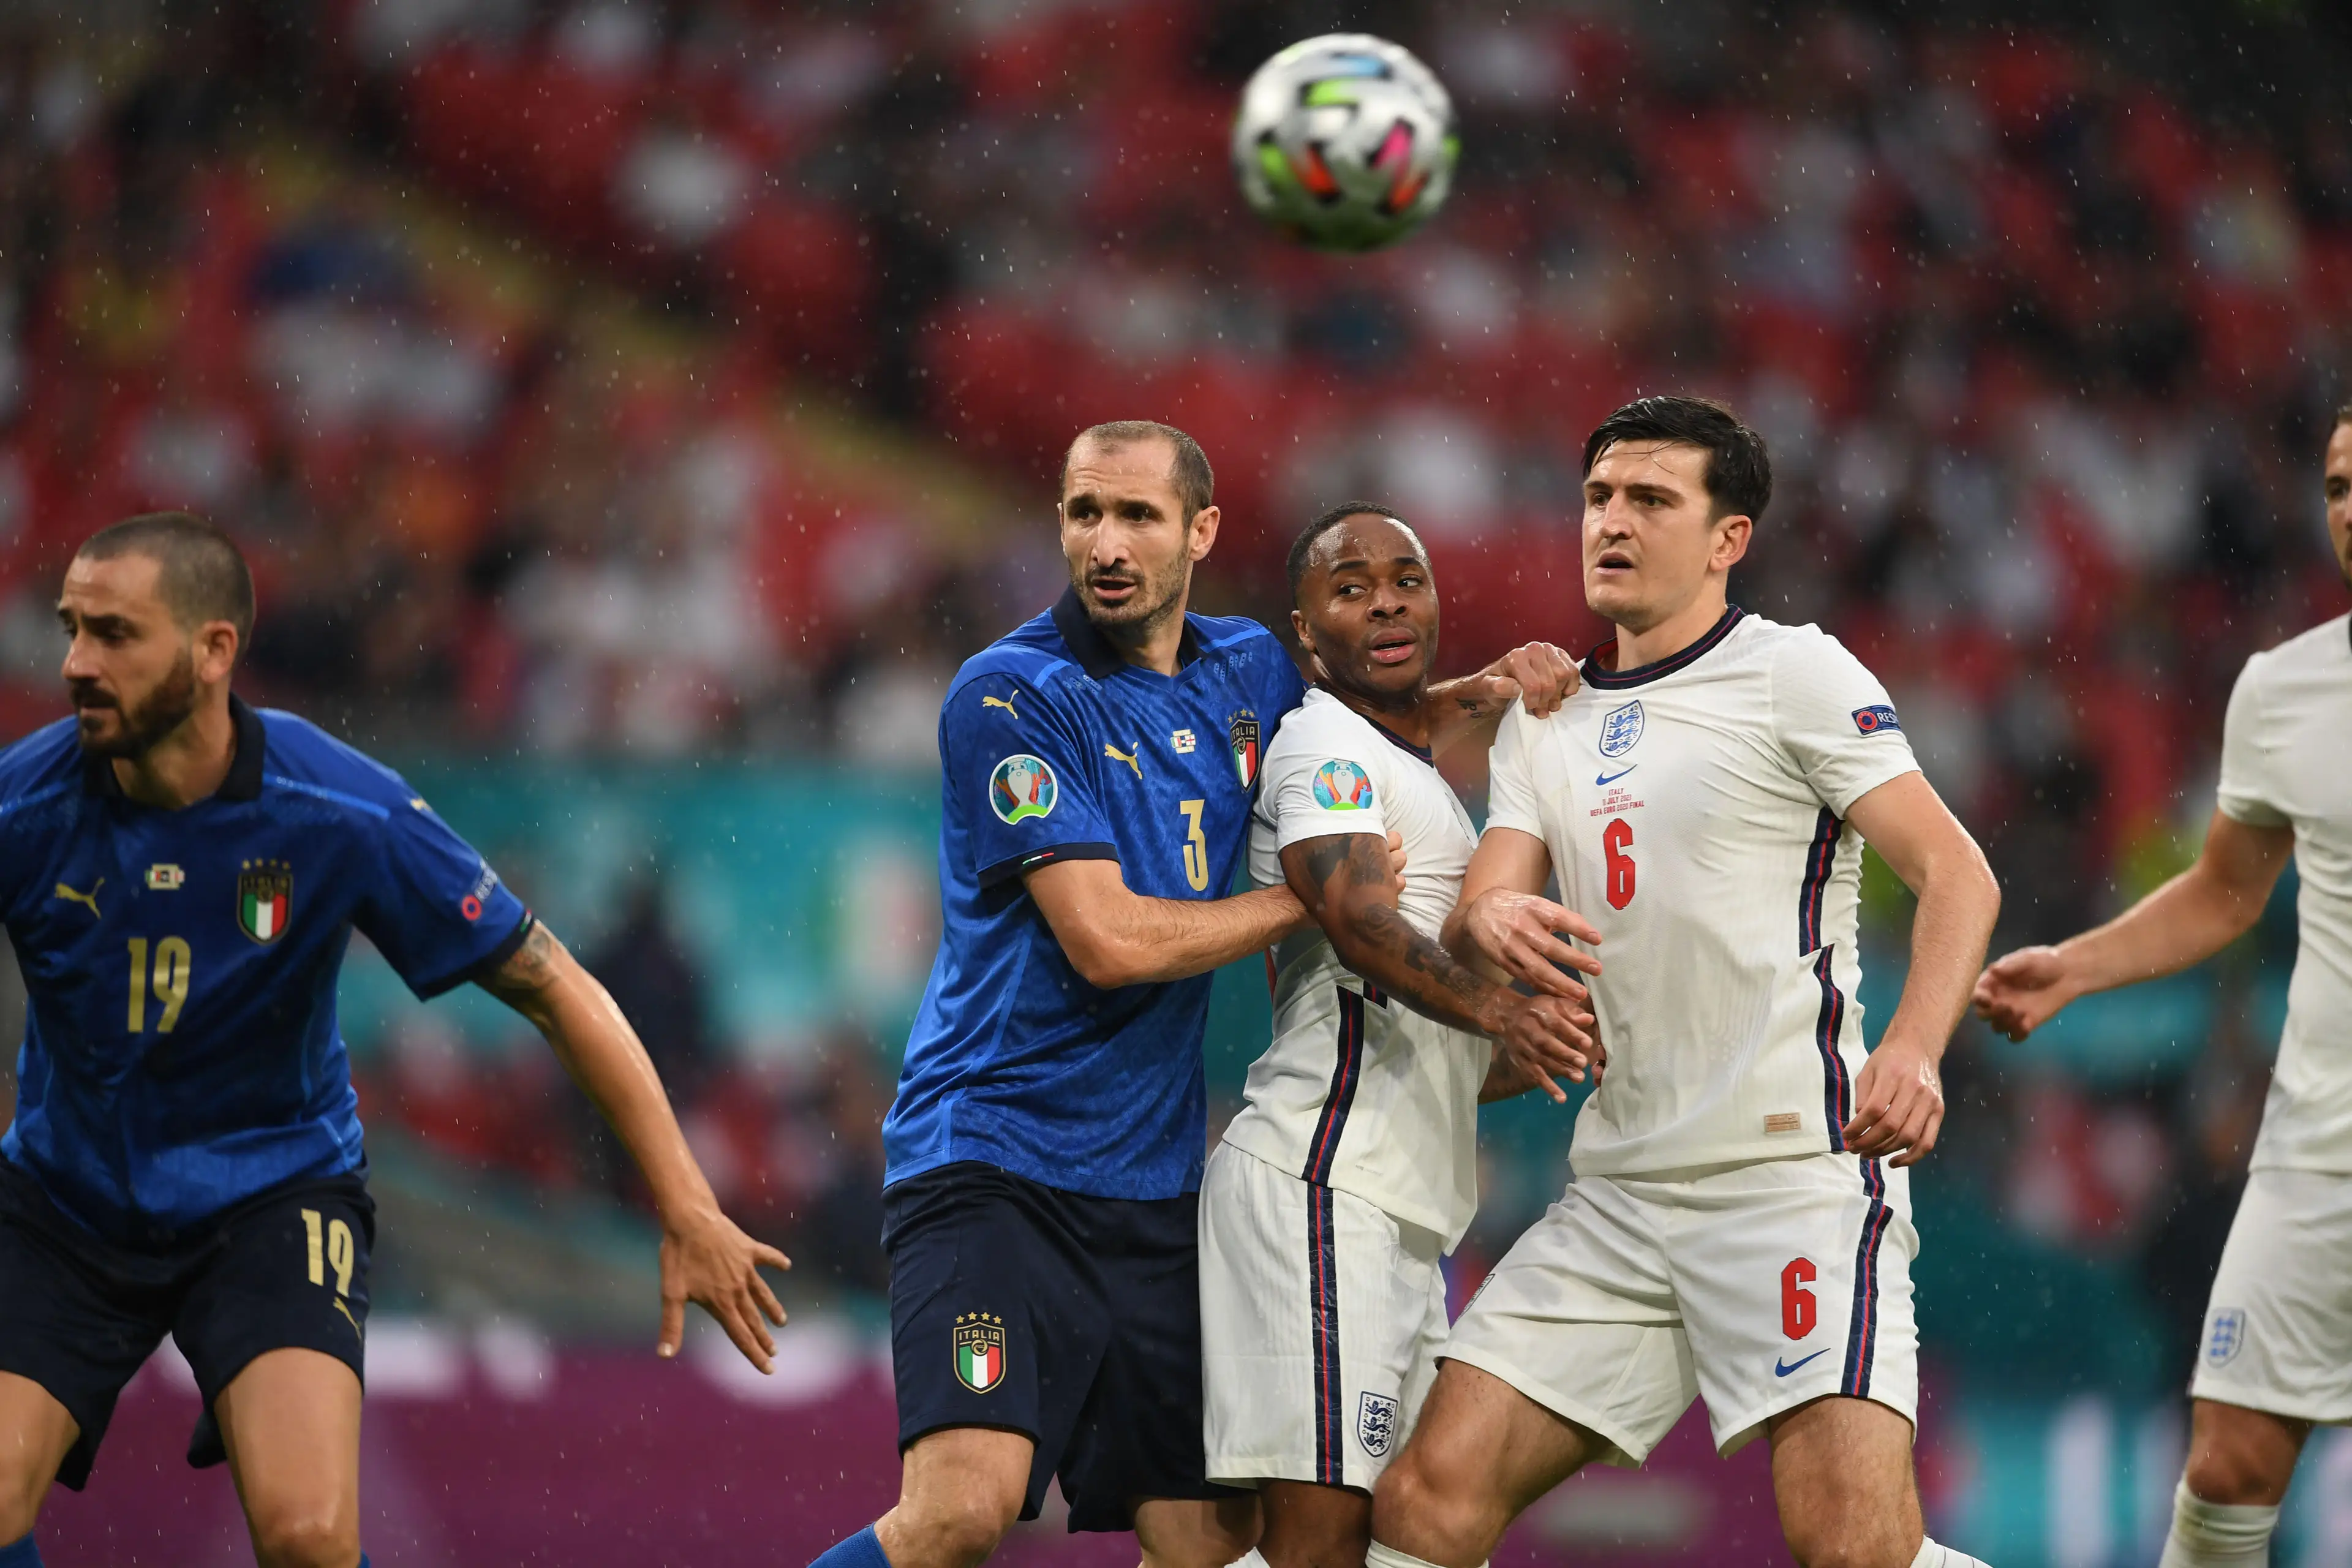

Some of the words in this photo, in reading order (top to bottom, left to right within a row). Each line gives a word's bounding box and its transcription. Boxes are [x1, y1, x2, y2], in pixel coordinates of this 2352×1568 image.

[1231, 726, 1255, 742] ITALIA
[1590, 808, 1603, 816] UEFA
[1604, 805, 1616, 815] EURO
[1617, 803, 1629, 812] 2020
[1629, 800, 1645, 809] FINAL
[1607, 796, 1619, 805] JULY
[1608, 788, 1624, 796] ITALY
[1180, 799, 1208, 891] 3
[1603, 818, 1635, 910] 6
[127, 935, 191, 1033] 19
[301, 1208, 355, 1298] 19
[1781, 1257, 1817, 1341] 6
[959, 1330, 1000, 1341] ITALIA
